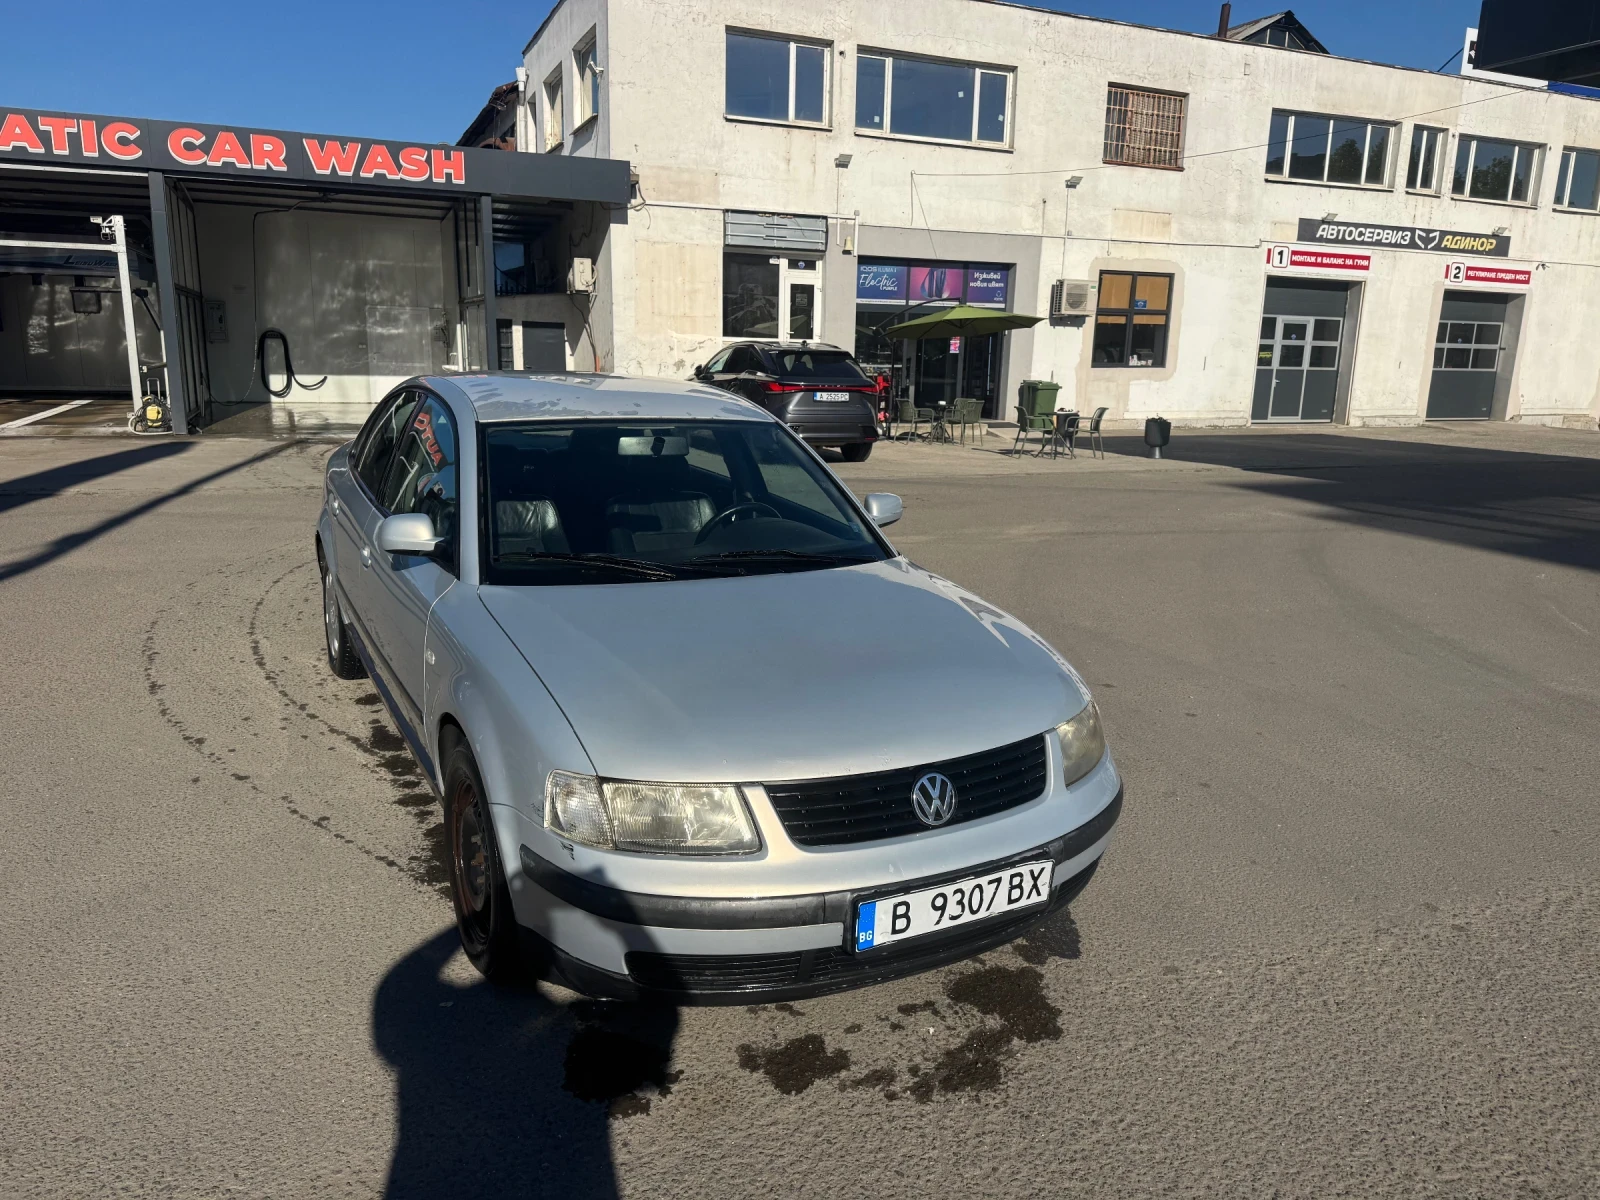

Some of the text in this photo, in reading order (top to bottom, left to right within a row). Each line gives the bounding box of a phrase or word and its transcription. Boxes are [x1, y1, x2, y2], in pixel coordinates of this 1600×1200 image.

[0, 114, 466, 184] ATIC CAR WASH
[1316, 224, 1496, 251] АВТОСЕРВИЗ АДИНОР
[1277, 250, 1284, 264] 1
[1292, 254, 1315, 262] МОНТАЖ
[1323, 256, 1344, 264] БАЛАНС
[1354, 258, 1370, 266] ГУМИ
[1453, 266, 1462, 279] 2
[859, 273, 898, 290] Electric
[891, 867, 1046, 936] B 9307 BX
[859, 930, 873, 943] BG
